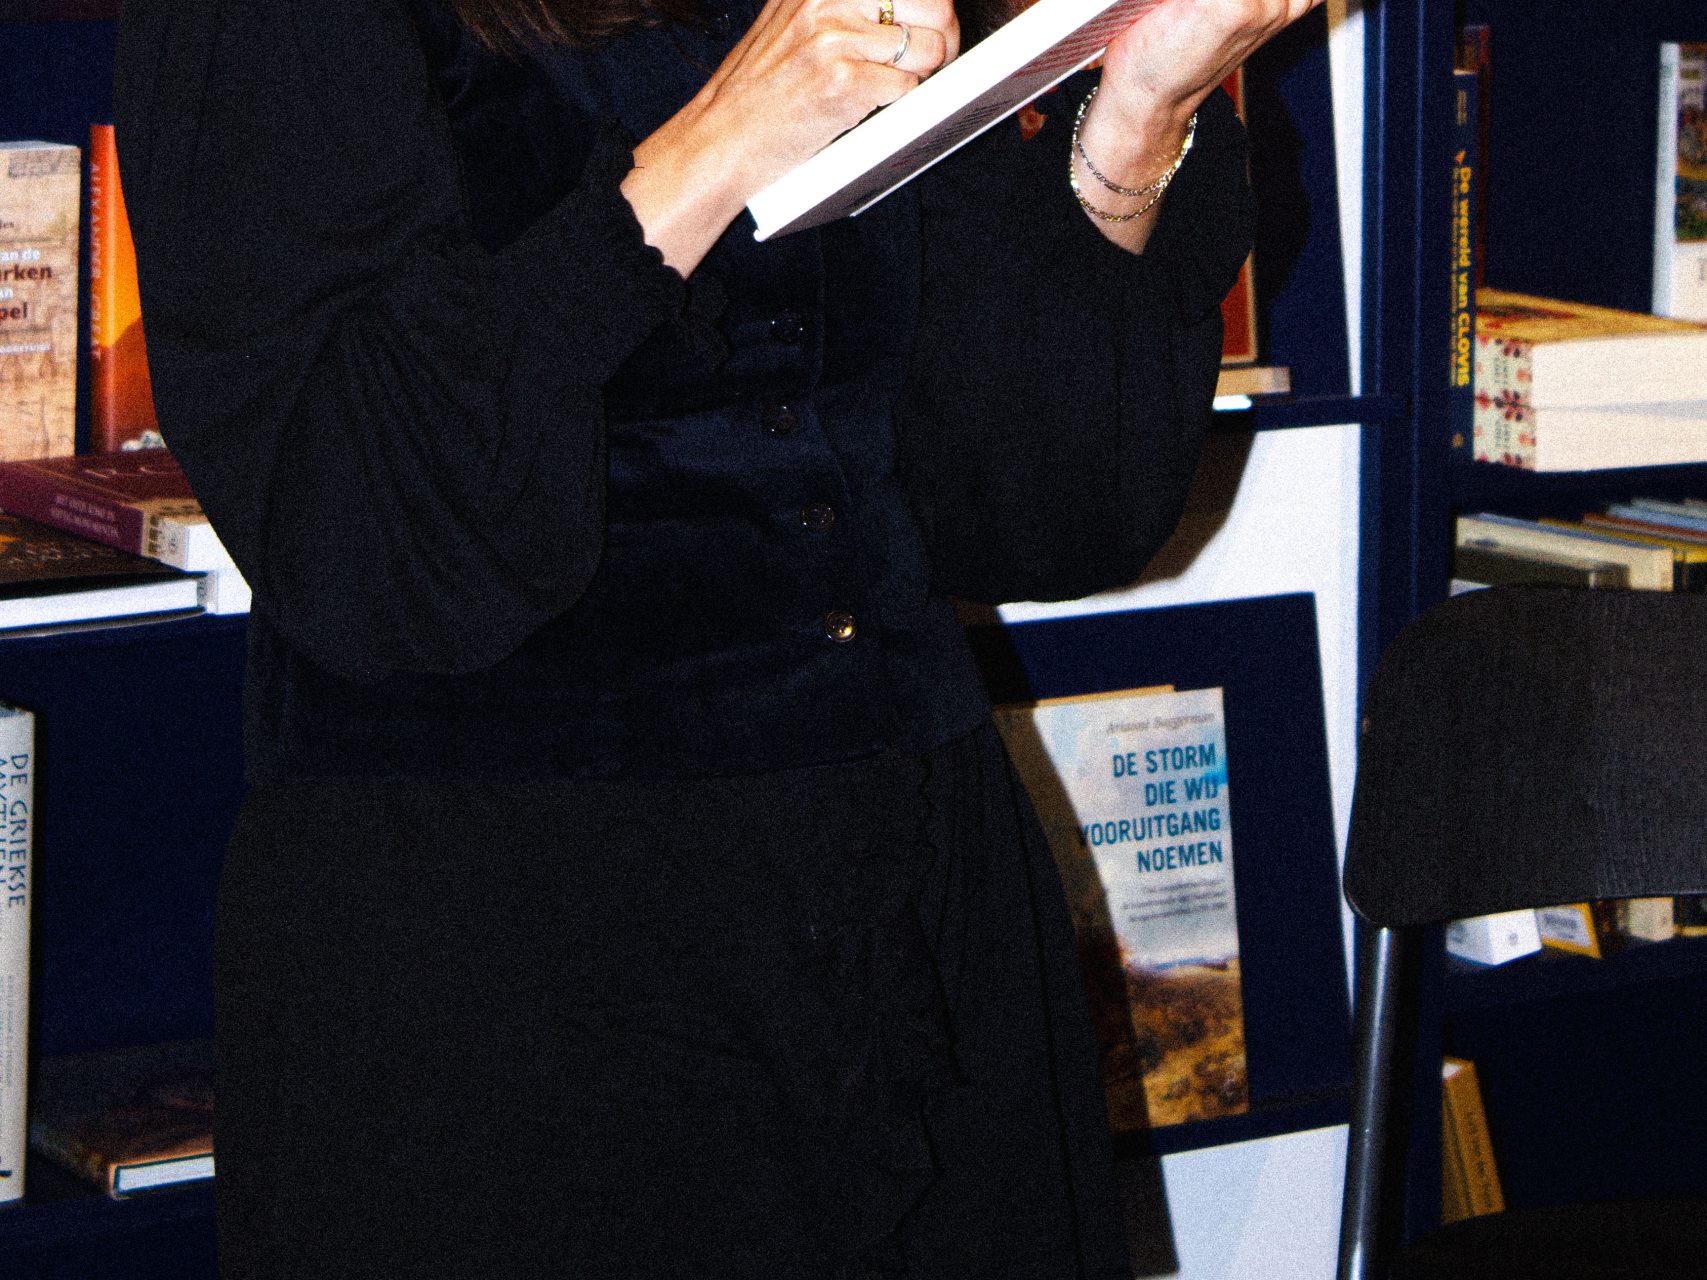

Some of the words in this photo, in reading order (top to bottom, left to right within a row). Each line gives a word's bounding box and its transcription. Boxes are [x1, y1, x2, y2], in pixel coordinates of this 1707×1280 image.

[1459, 166, 1472, 194] De
[1459, 198, 1472, 266] wereld
[1458, 272, 1470, 307] van
[1457, 312, 1471, 387] CLOVIS
[10, 753, 29, 787] DE
[1112, 752, 1138, 778] DE
[1145, 742, 1216, 774] STORM
[1144, 780, 1177, 807] DIE
[1184, 776, 1219, 803] WIJ
[9, 800, 28, 907] GRIEKSE
[1137, 840, 1223, 874] NOEMEN
